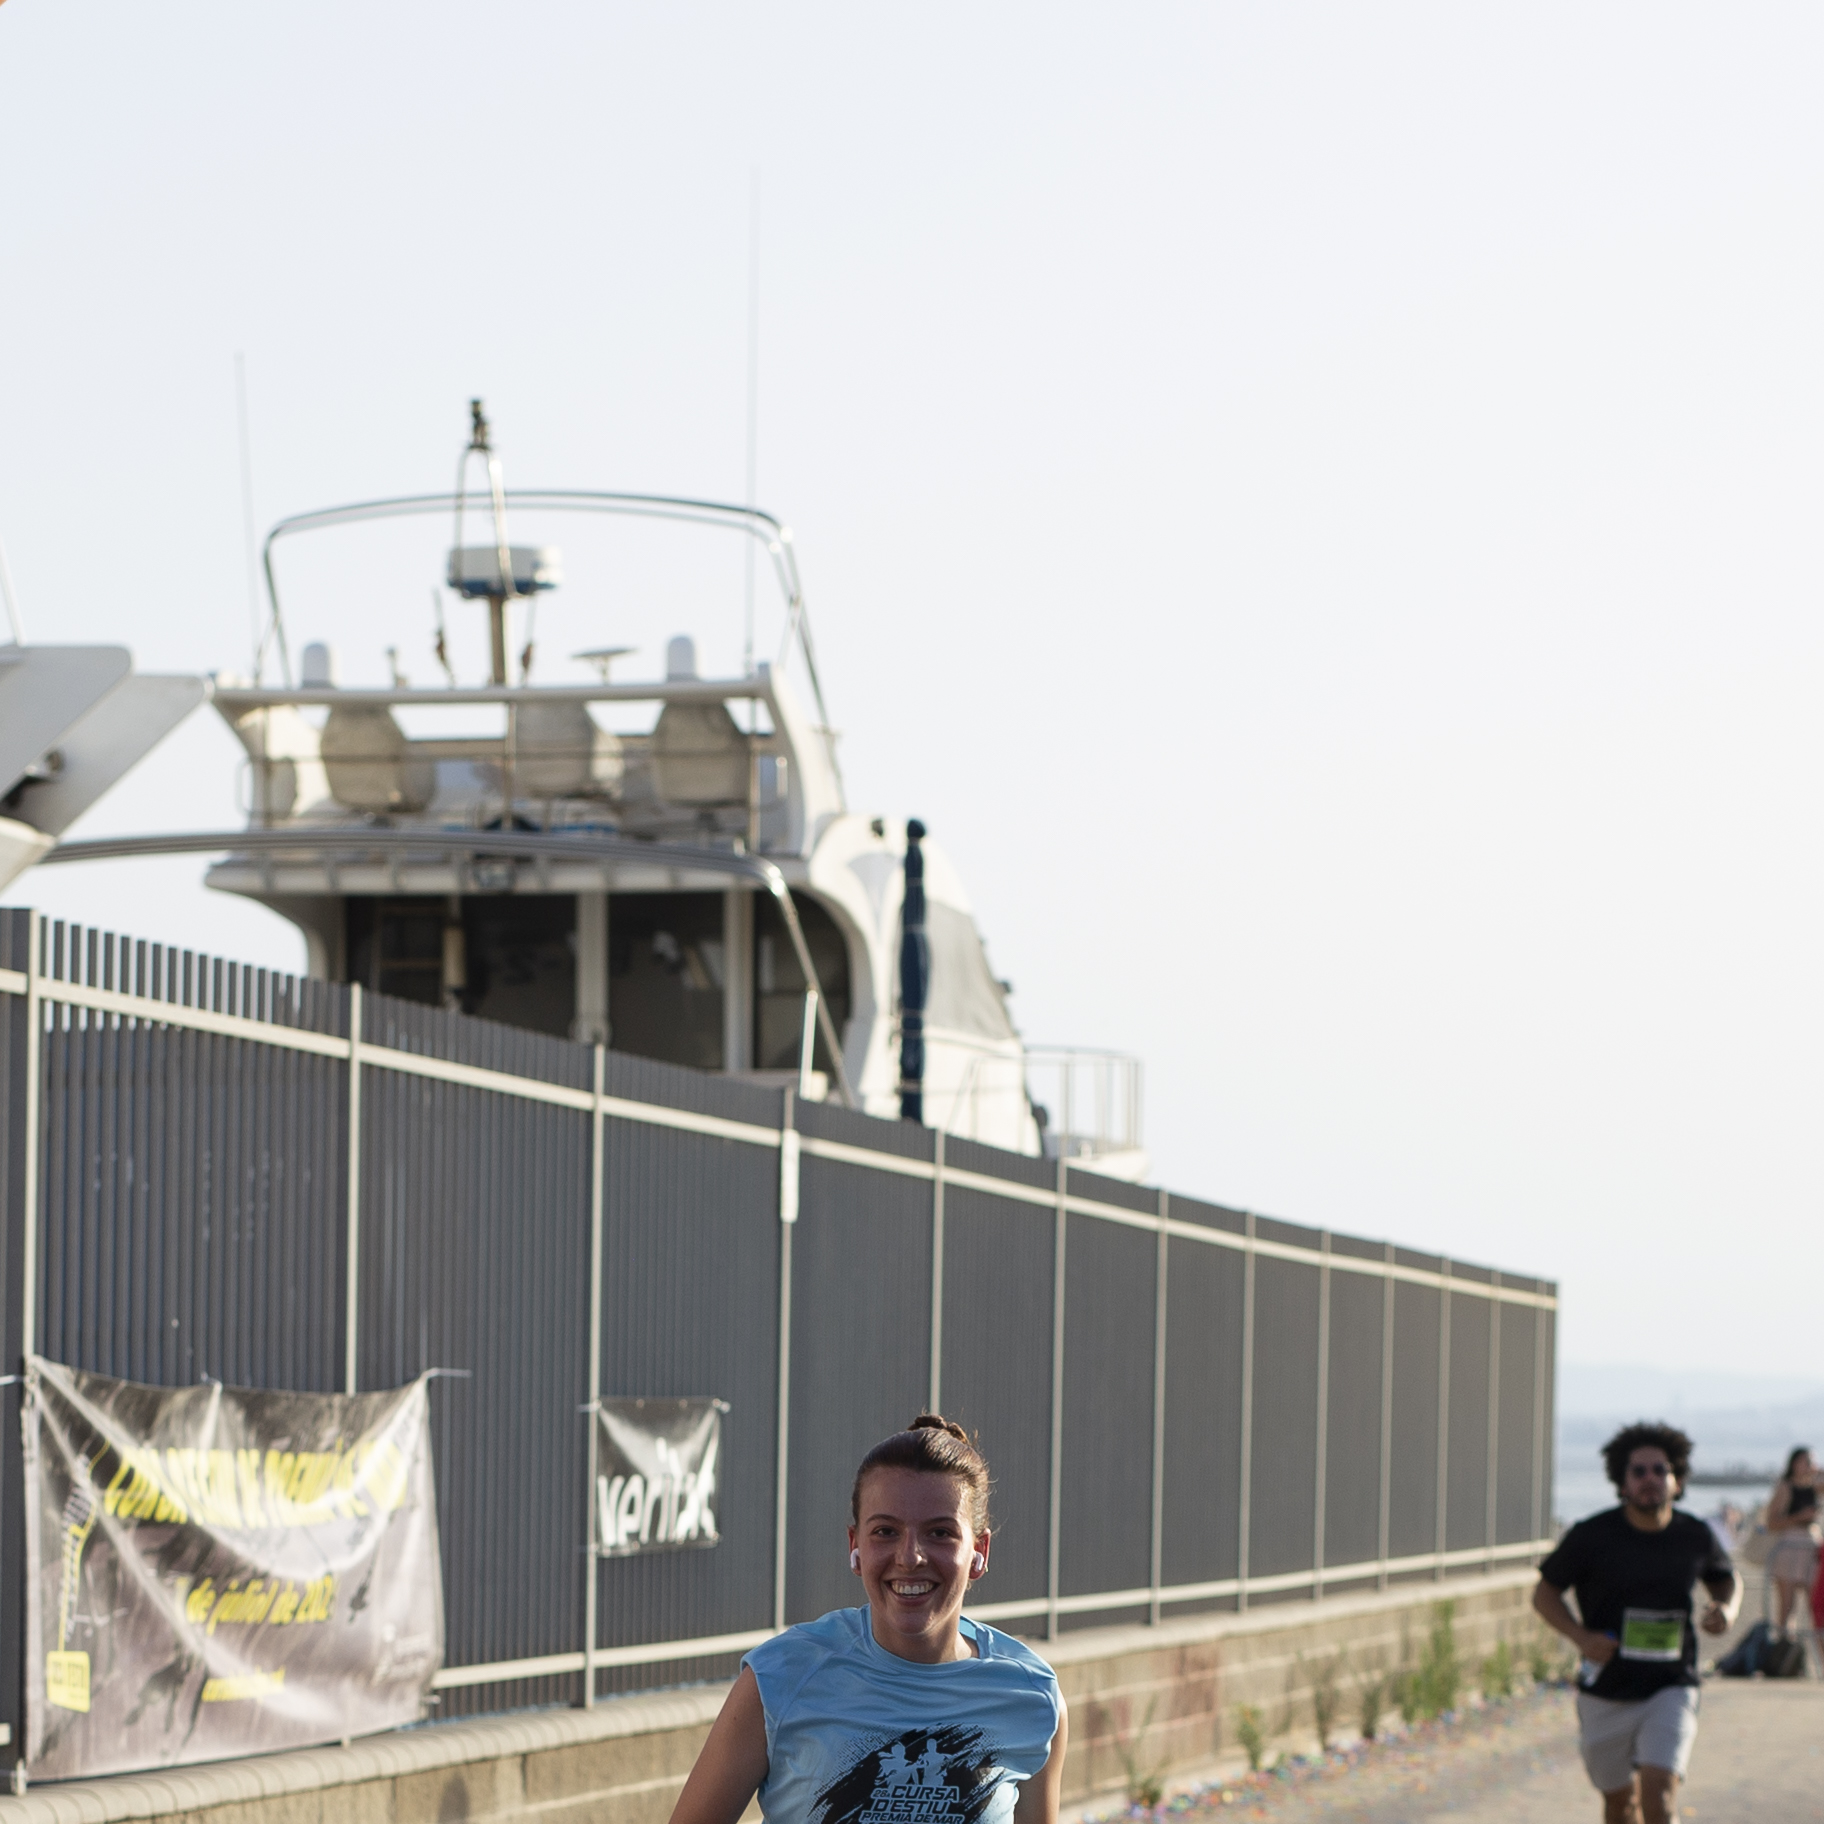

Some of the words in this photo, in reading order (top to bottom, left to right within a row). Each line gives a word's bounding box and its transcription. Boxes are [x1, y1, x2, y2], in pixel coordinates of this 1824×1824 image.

[891, 1785, 958, 1801] CURSA
[873, 1798, 949, 1815] D'ESTIU
[913, 1813, 934, 1824] DE
